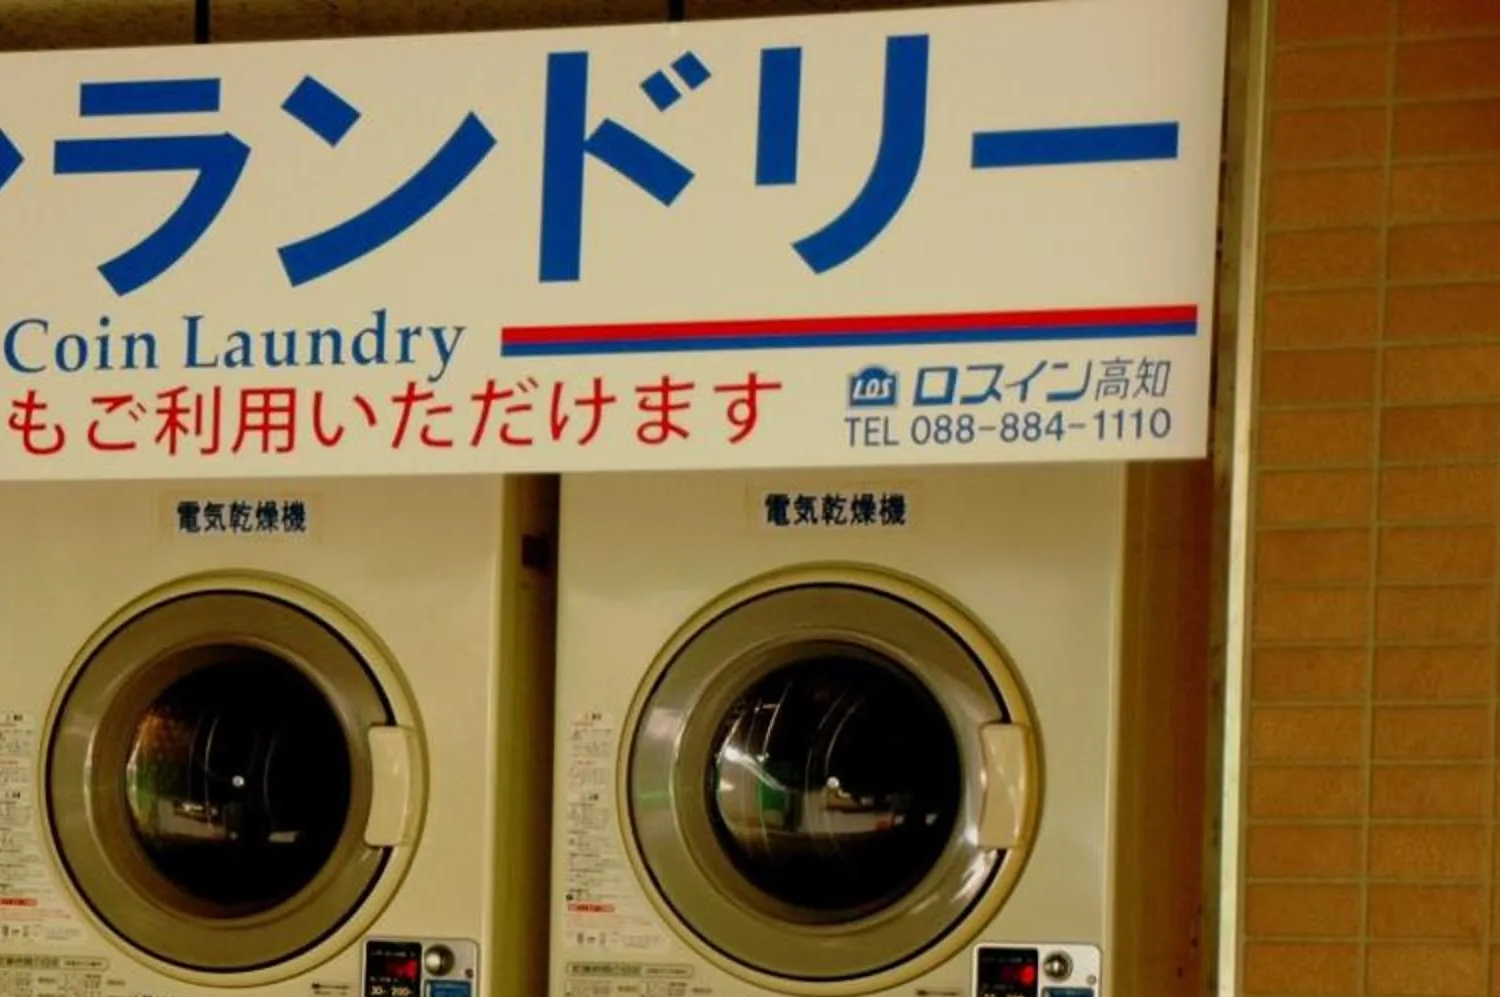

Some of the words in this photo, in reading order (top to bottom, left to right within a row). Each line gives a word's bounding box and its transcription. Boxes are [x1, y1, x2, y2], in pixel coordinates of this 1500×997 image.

[3, 317, 159, 374] Coin
[184, 309, 465, 383] Laundry
[852, 378, 893, 399] LOS
[844, 415, 899, 447] TEL
[910, 407, 1172, 445] 088-884-1110
[176, 500, 307, 534] 電気乾燥機
[765, 493, 908, 527] 電気乾燥機
